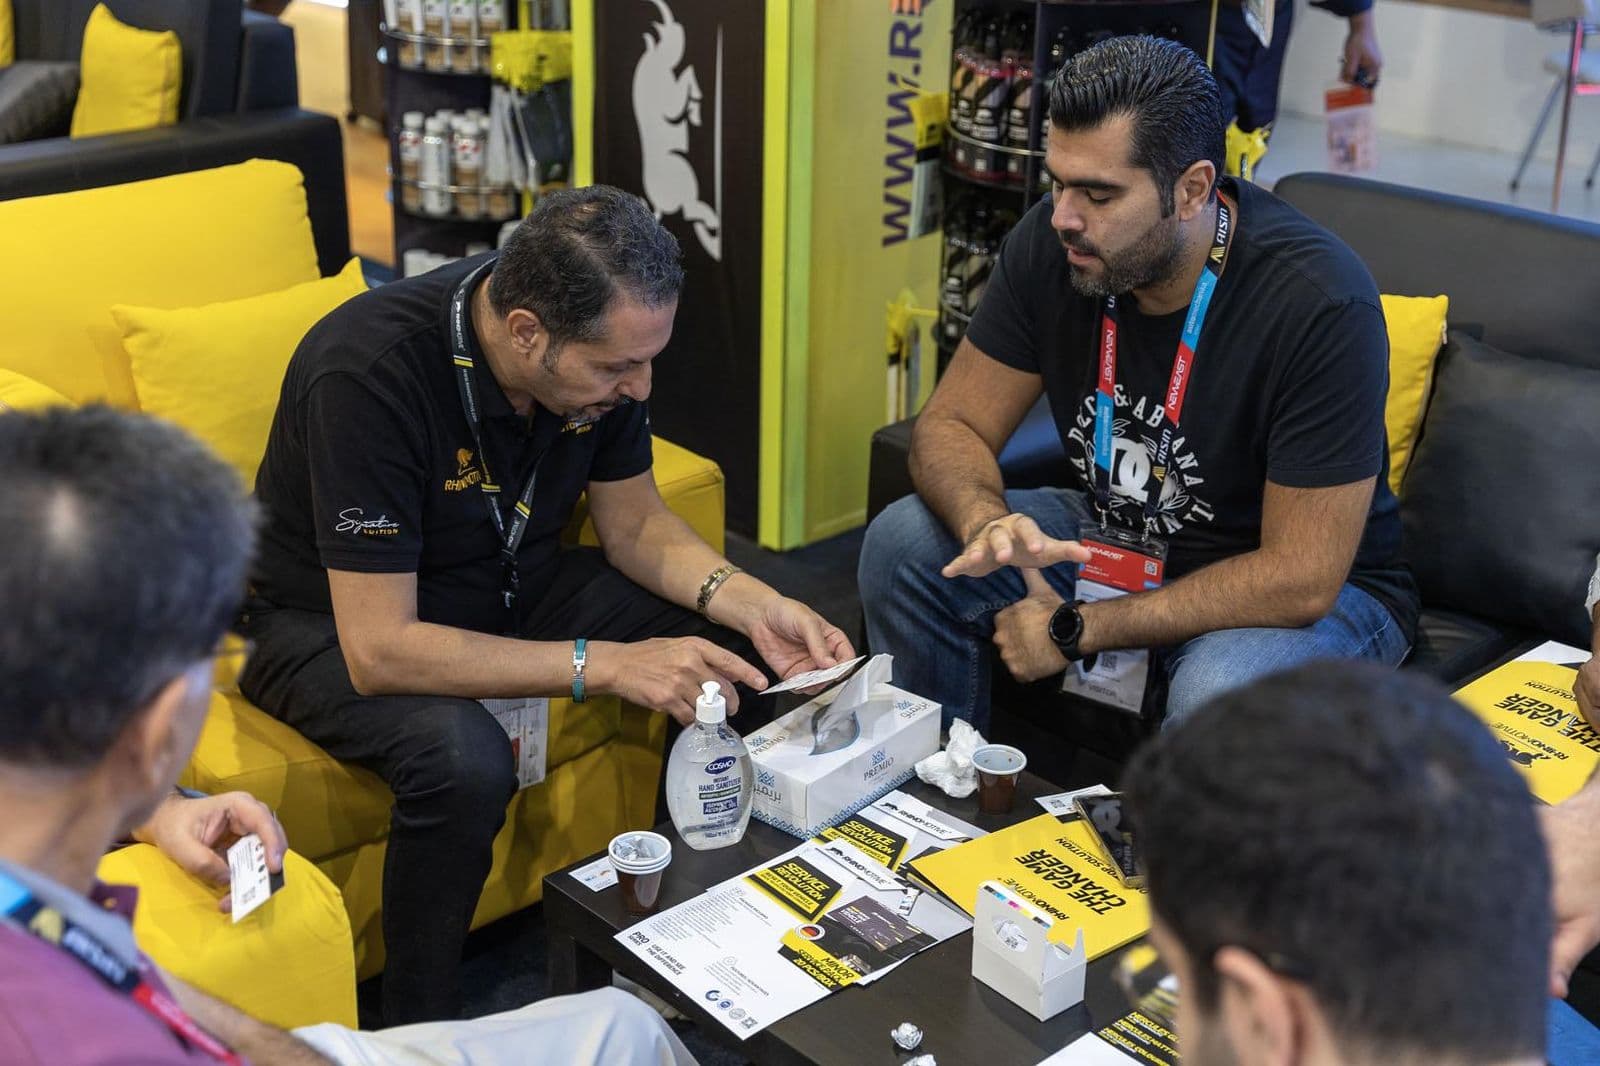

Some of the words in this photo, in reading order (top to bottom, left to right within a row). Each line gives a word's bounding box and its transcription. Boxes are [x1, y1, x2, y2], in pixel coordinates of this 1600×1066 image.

[1215, 206, 1229, 245] AISIN
[1103, 328, 1114, 385] NEWEAST
[1167, 355, 1188, 411] NEWEAST
[1157, 428, 1172, 464] AISIN
[335, 507, 400, 535] Signature
[362, 528, 399, 536] EDITION
[1493, 699, 1560, 728] GAME
[751, 733, 786, 757] PREMIO
[707, 760, 734, 771] COSMO
[862, 756, 895, 781] PREMIO
[698, 784, 715, 792] HAND
[845, 820, 897, 846] SERVICE
[899, 809, 948, 836] RHINOMOTIVE
[839, 825, 895, 855] REVOLUTION
[1055, 838, 1106, 868] SOLUTION
[783, 862, 830, 892] SERVICE
[842, 852, 888, 885] RHINOMOTIVE
[1014, 856, 1073, 890] GAME
[1029, 849, 1126, 908] CHANGER
[774, 866, 827, 901] REVOLUTION
[1003, 878, 1070, 921] RHINOMOTIVE
[1067, 889, 1112, 915] THE
[632, 931, 650, 944] PRO
[646, 947, 657, 956] THE
[654, 954, 683, 976] DIFFERENCE
[651, 944, 662, 952] USE
[665, 955, 677, 964] AND
[820, 957, 855, 979] MINOR
